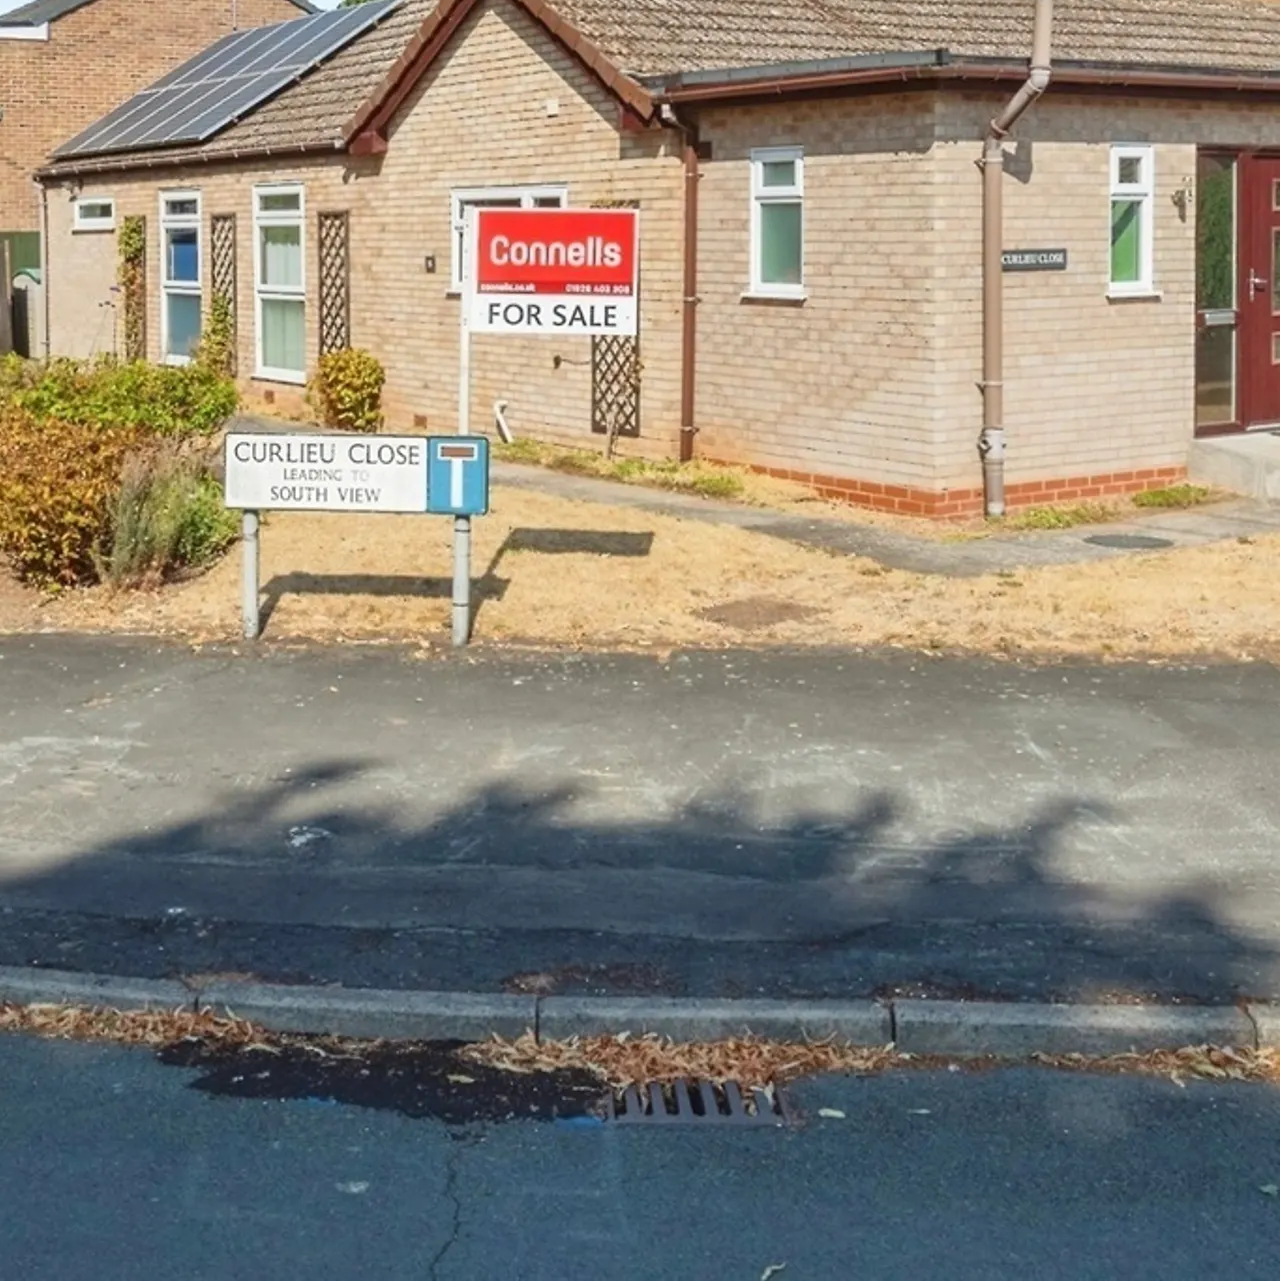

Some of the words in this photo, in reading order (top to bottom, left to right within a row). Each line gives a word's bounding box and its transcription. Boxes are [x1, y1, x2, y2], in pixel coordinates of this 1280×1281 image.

[489, 234, 623, 268] Connells
[487, 302, 543, 326] FOR
[552, 304, 617, 327] SALE
[234, 441, 335, 464] CURLIEU
[348, 443, 420, 466] CLOSE
[283, 468, 343, 482] LEADING
[352, 470, 370, 483] TO
[270, 486, 328, 503] SOUTH
[337, 487, 382, 504] VIEW
